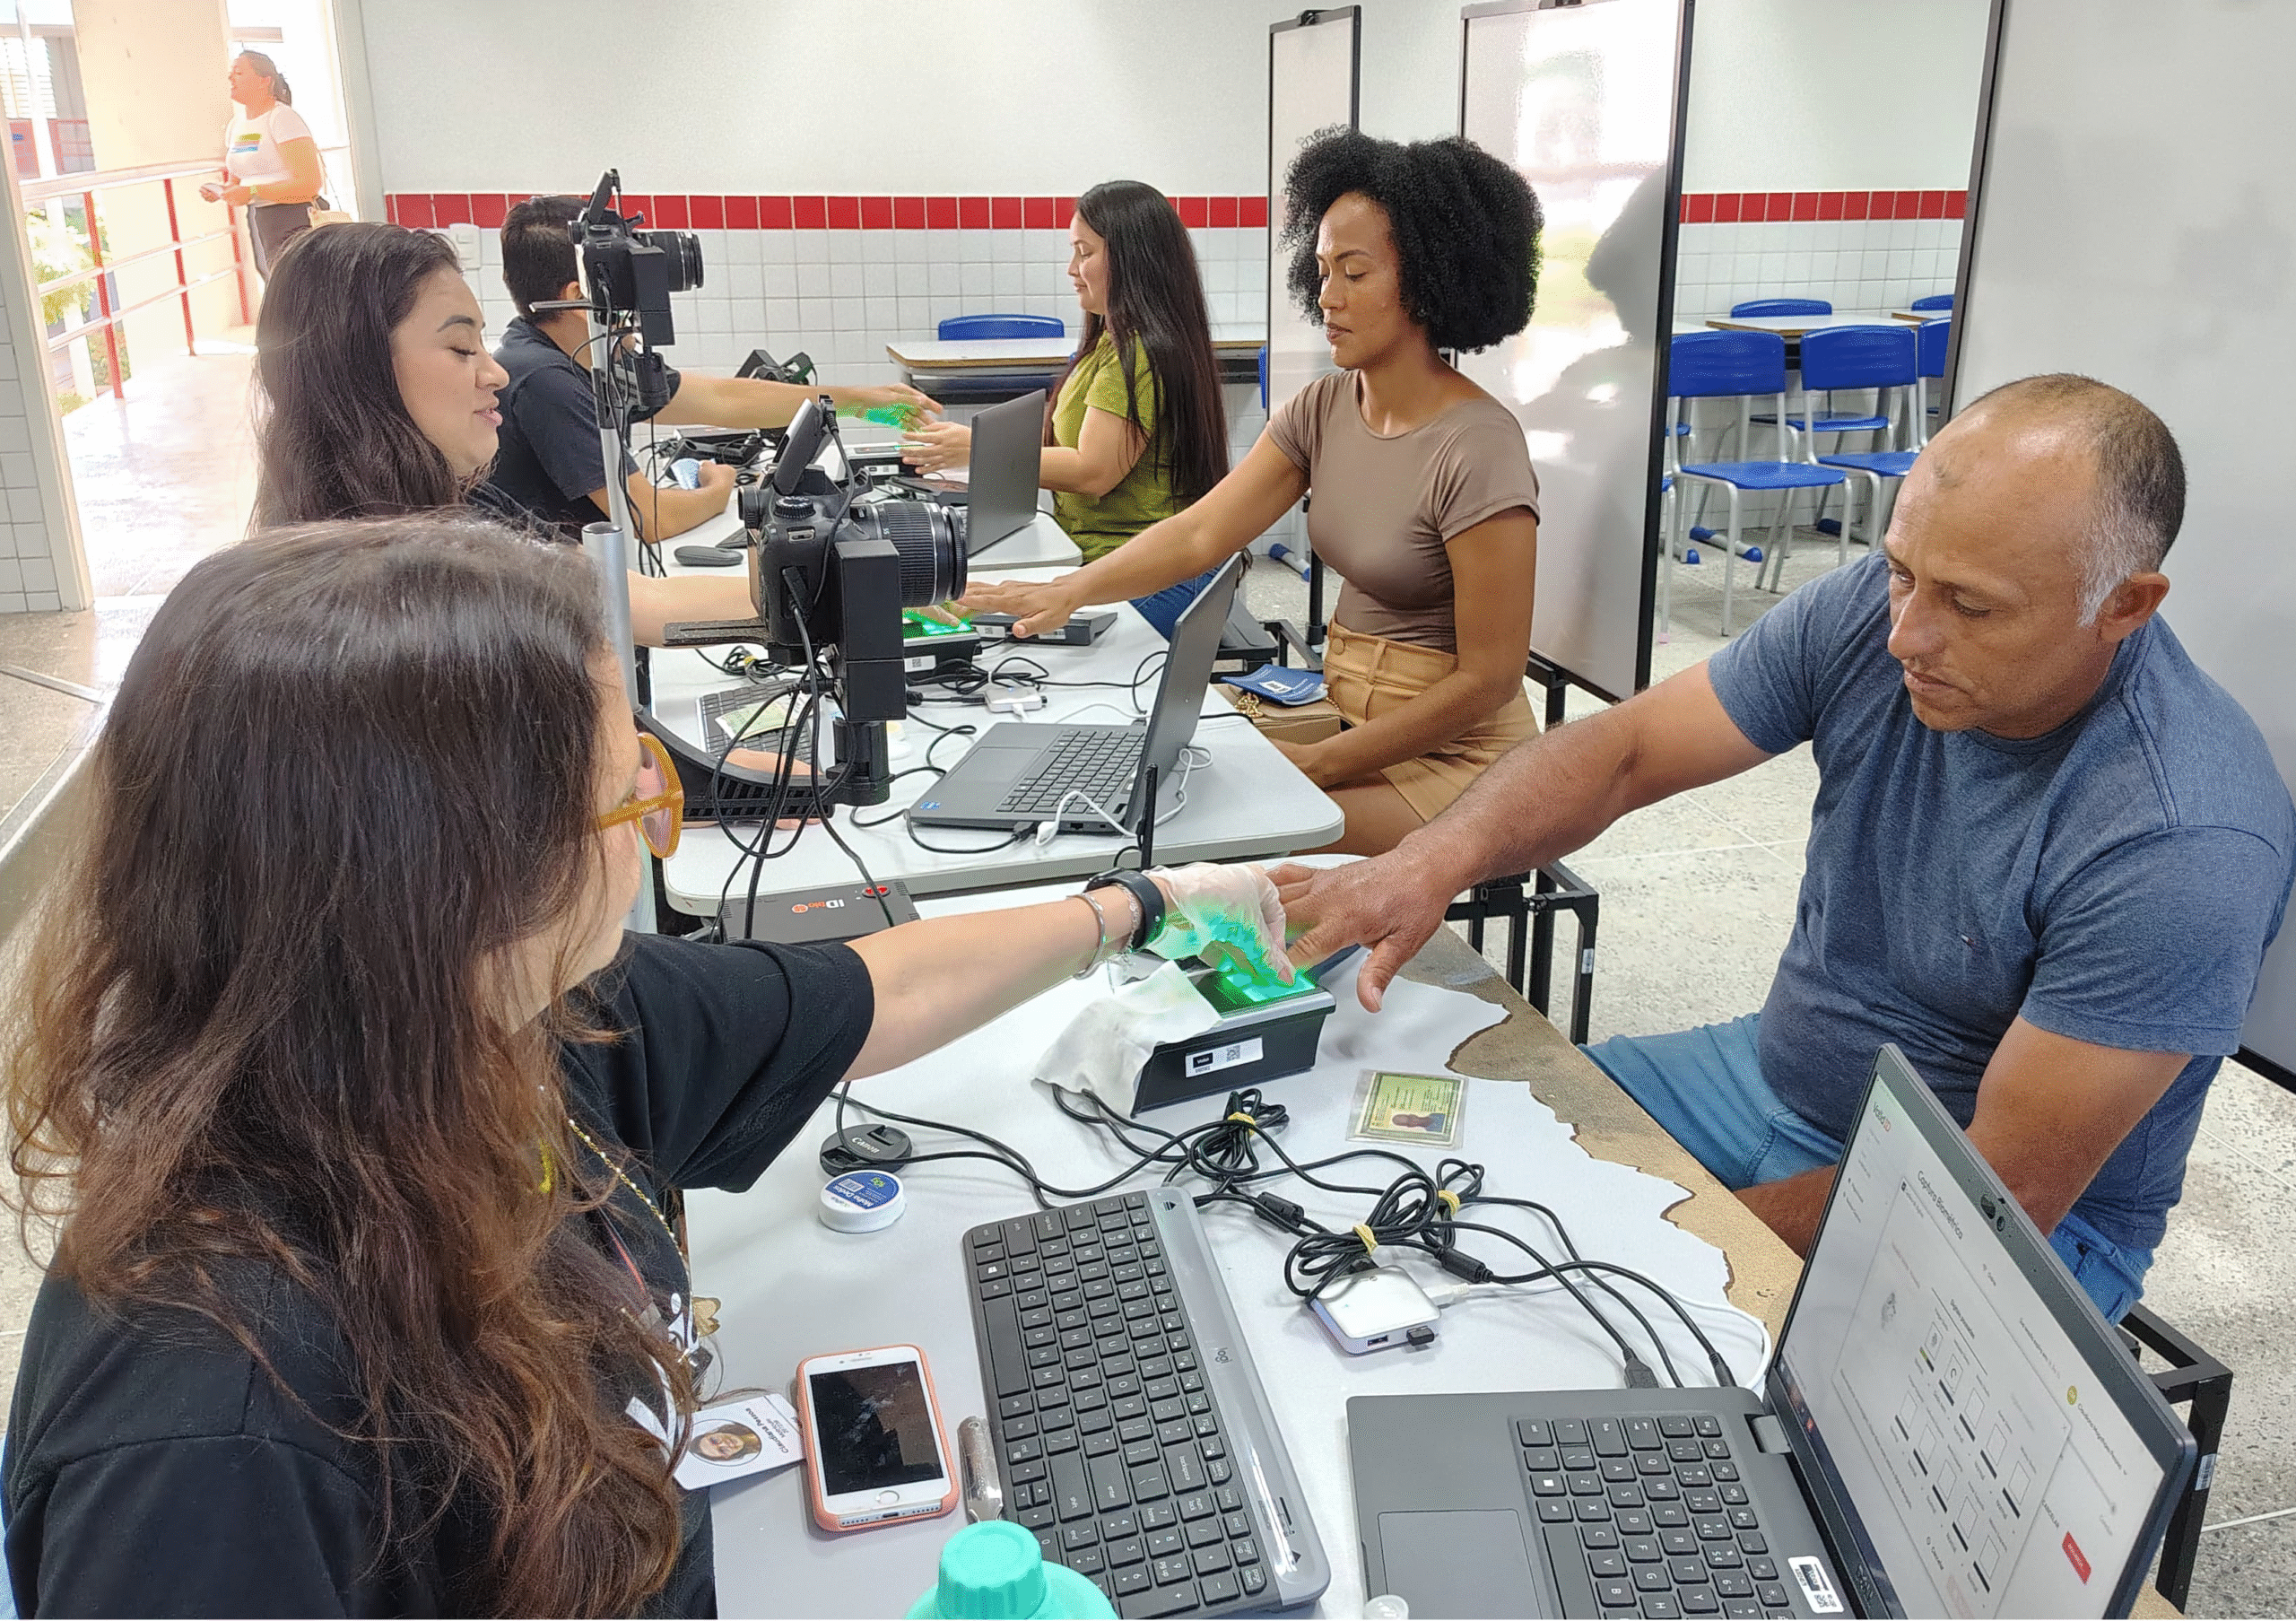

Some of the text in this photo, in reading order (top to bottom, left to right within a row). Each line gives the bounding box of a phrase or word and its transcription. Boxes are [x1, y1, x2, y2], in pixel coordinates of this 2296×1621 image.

[851, 1136, 880, 1155] Canon
[1916, 1168, 1964, 1242] Captura Biométrica
[1213, 1346, 1233, 1364] logi
[744, 1407, 763, 1426] Pessoa
[761, 1425, 788, 1453] Claudiana
[1178, 1455, 1191, 1481] backspace
[1656, 1483, 1666, 1491] W
[1070, 1496, 1078, 1509] shift
[1147, 1507, 1155, 1523] home
[1251, 1568, 1262, 1583] page
